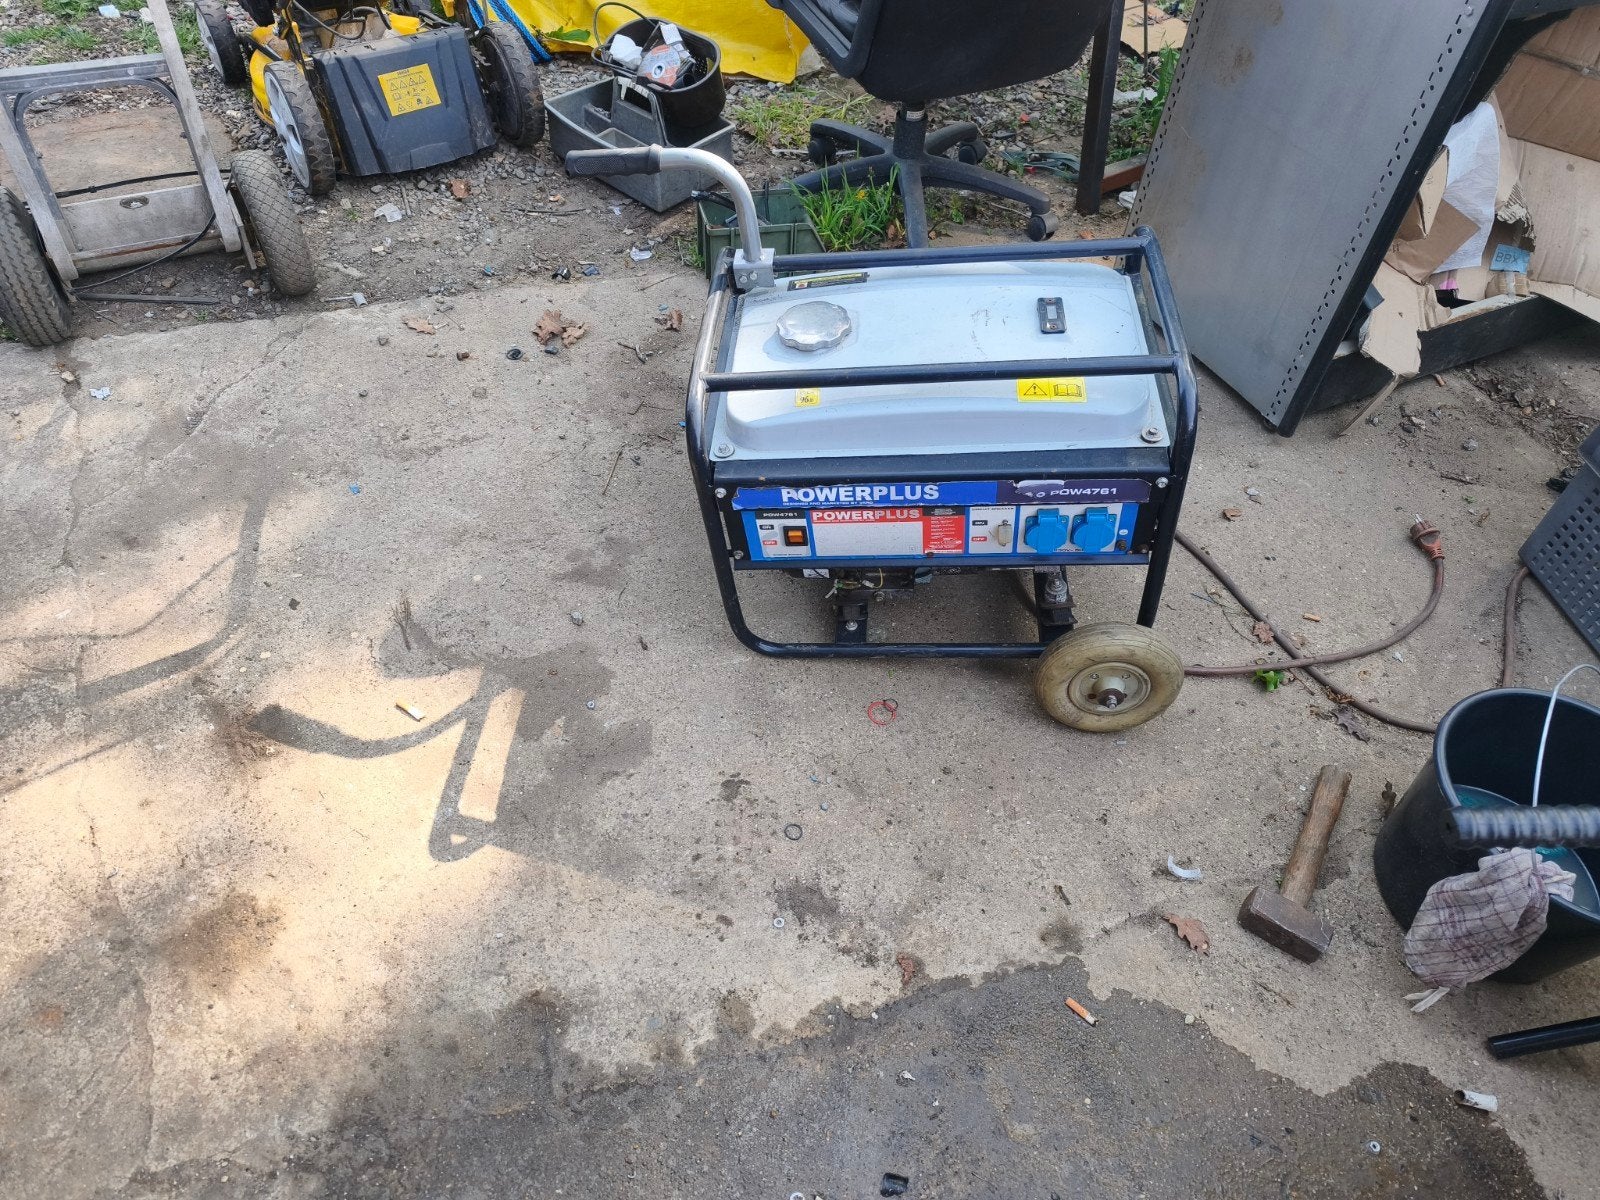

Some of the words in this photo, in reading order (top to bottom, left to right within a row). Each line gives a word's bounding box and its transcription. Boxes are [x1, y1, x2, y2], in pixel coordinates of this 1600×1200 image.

[781, 484, 940, 503] POWERPLUS
[1050, 487, 1118, 496] POW4761
[812, 509, 921, 521] POWERPLUS
